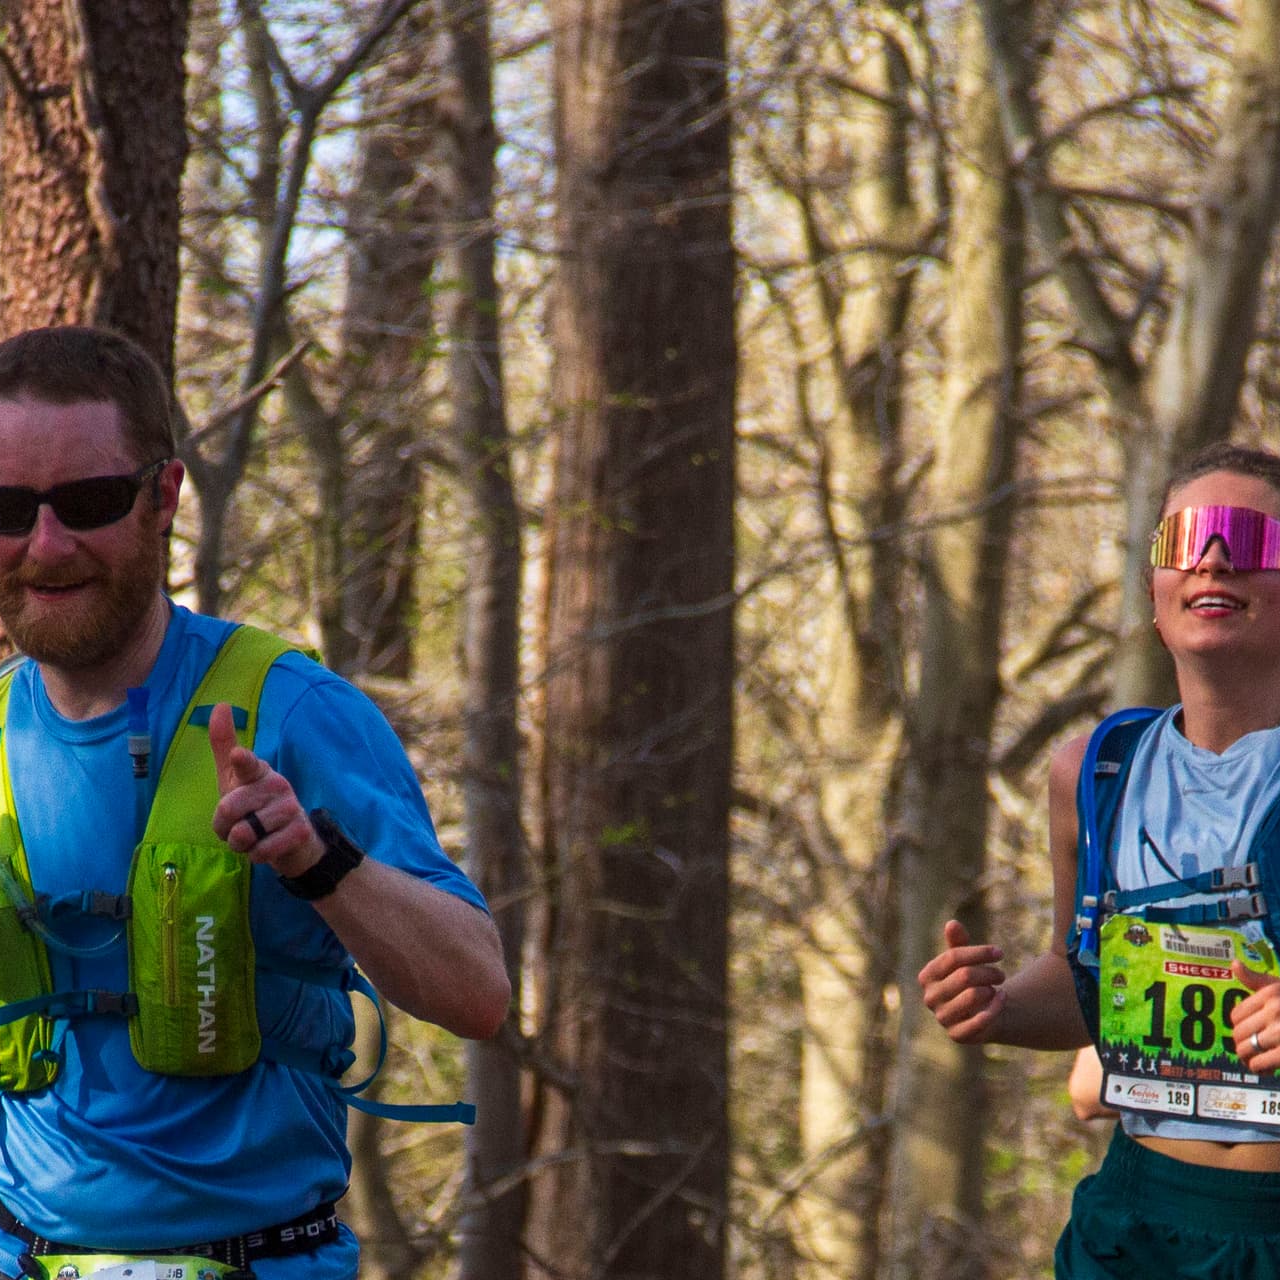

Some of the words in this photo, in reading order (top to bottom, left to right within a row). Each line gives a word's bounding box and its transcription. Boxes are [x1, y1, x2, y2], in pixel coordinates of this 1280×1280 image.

[1168, 963, 1230, 979] SHEETZ
[195, 915, 216, 1053] NATHAN
[1167, 1090, 1190, 1106] 189
